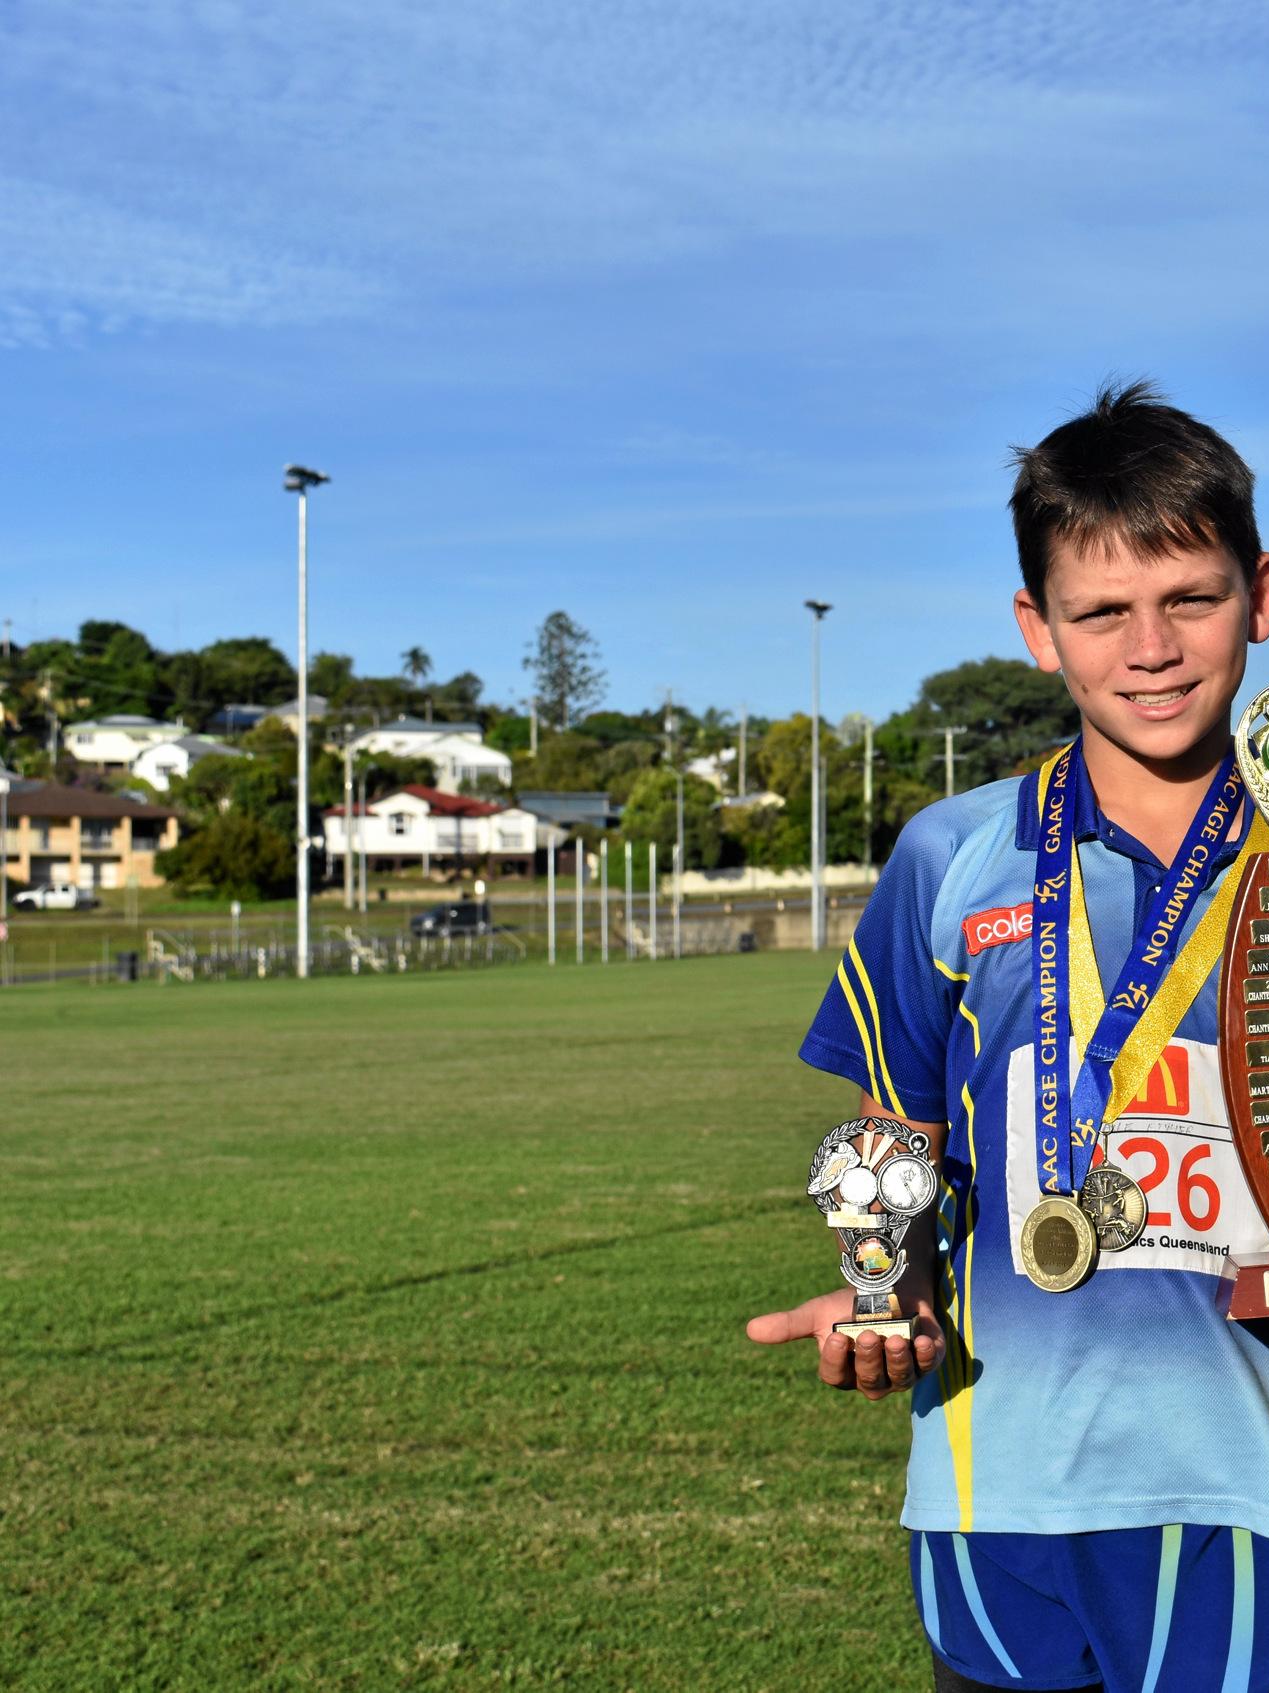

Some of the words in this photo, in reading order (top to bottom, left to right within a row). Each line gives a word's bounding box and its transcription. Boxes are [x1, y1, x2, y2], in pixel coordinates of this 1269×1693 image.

[1054, 750, 1072, 788] AGE
[1223, 762, 1244, 799] AC
[1045, 794, 1065, 853] GAAC
[1200, 797, 1230, 842] AGE
[976, 910, 1033, 944] cole
[1141, 844, 1209, 967] CHAMPION
[1040, 922, 1057, 1066] CHAMPION
[1042, 1072, 1058, 1128] AGE
[1043, 1137, 1060, 1193] AAC
[1092, 1136, 1222, 1232] 26
[1159, 1235, 1230, 1257] Queensland
